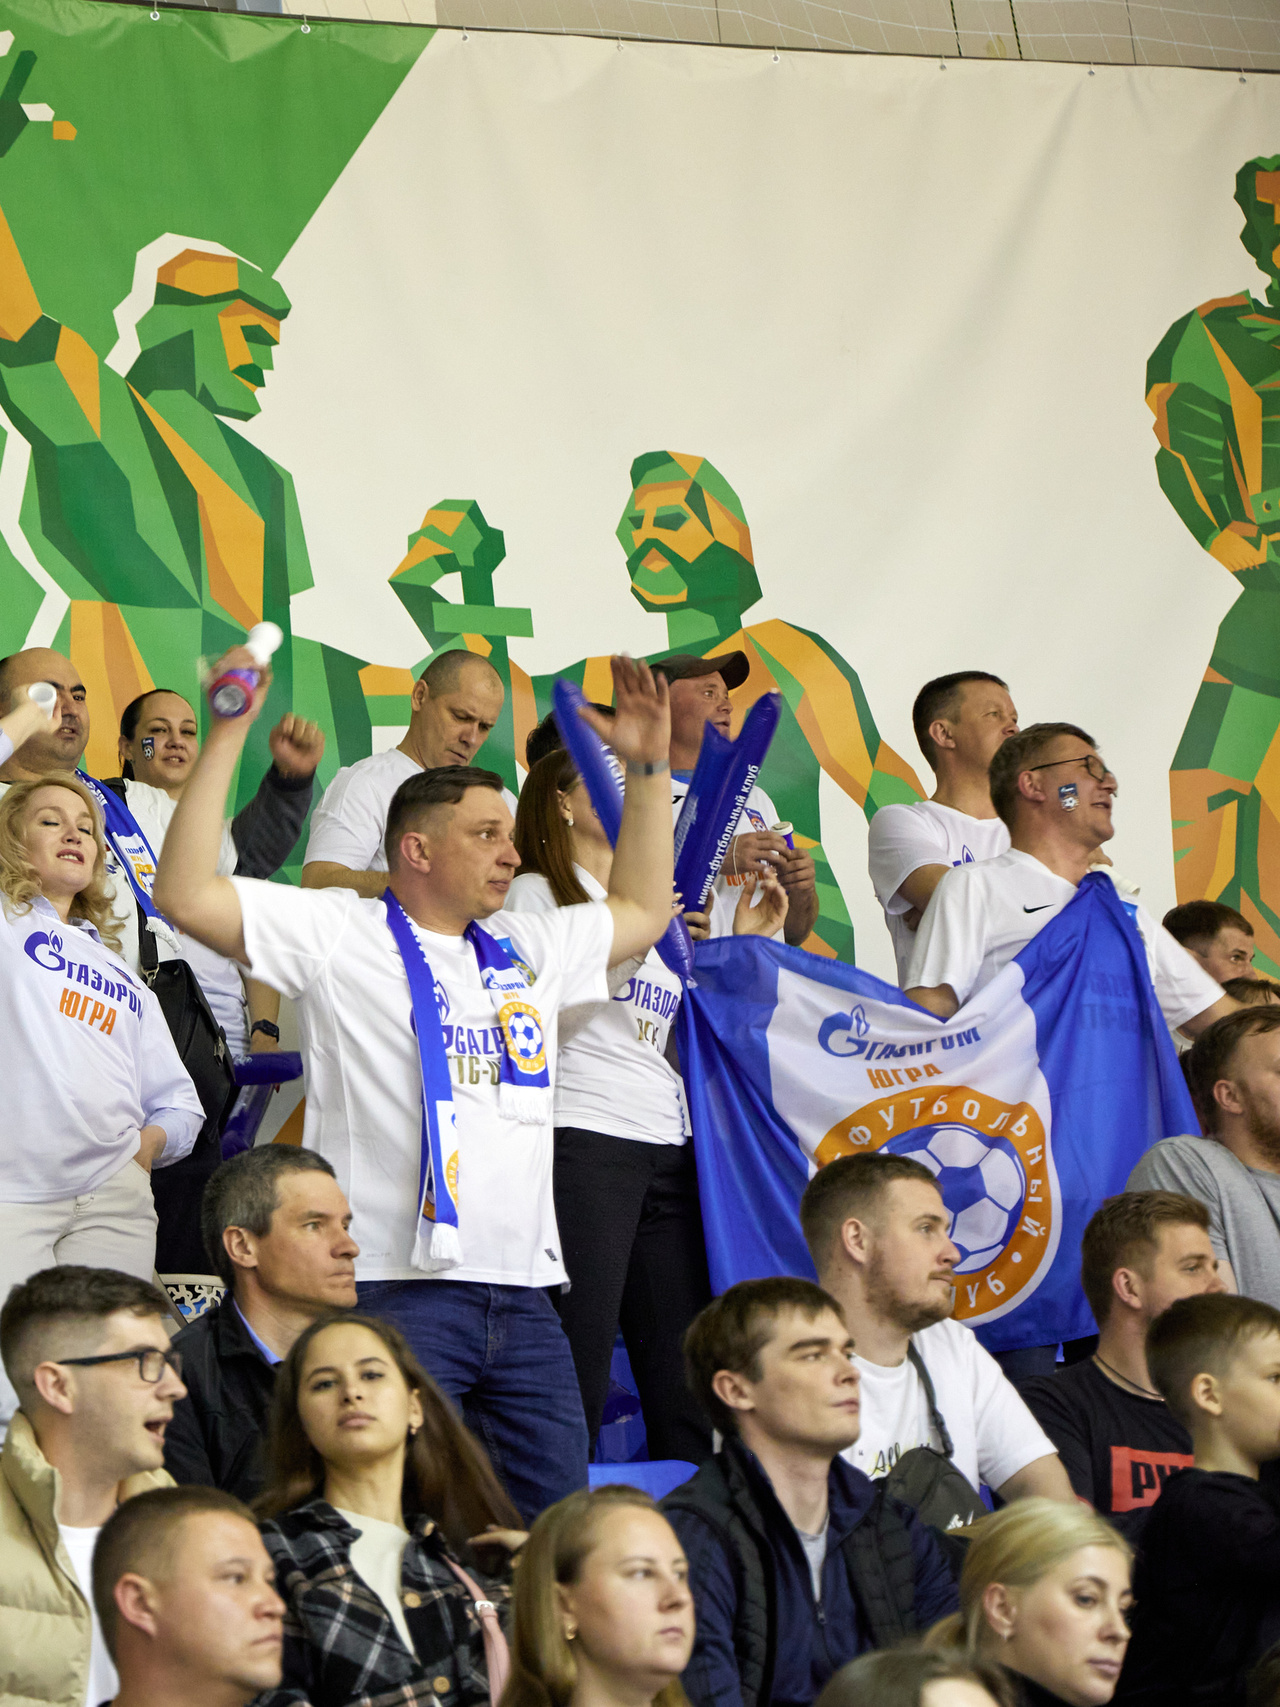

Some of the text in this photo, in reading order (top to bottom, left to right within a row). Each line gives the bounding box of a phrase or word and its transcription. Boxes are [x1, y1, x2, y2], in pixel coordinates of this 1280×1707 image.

[698, 795, 747, 905] мини-футбольный
[741, 764, 759, 794] клуб
[59, 987, 117, 1036] ЮГРА
[455, 1025, 505, 1056] GAZP
[866, 1063, 943, 1089] ЮГРА
